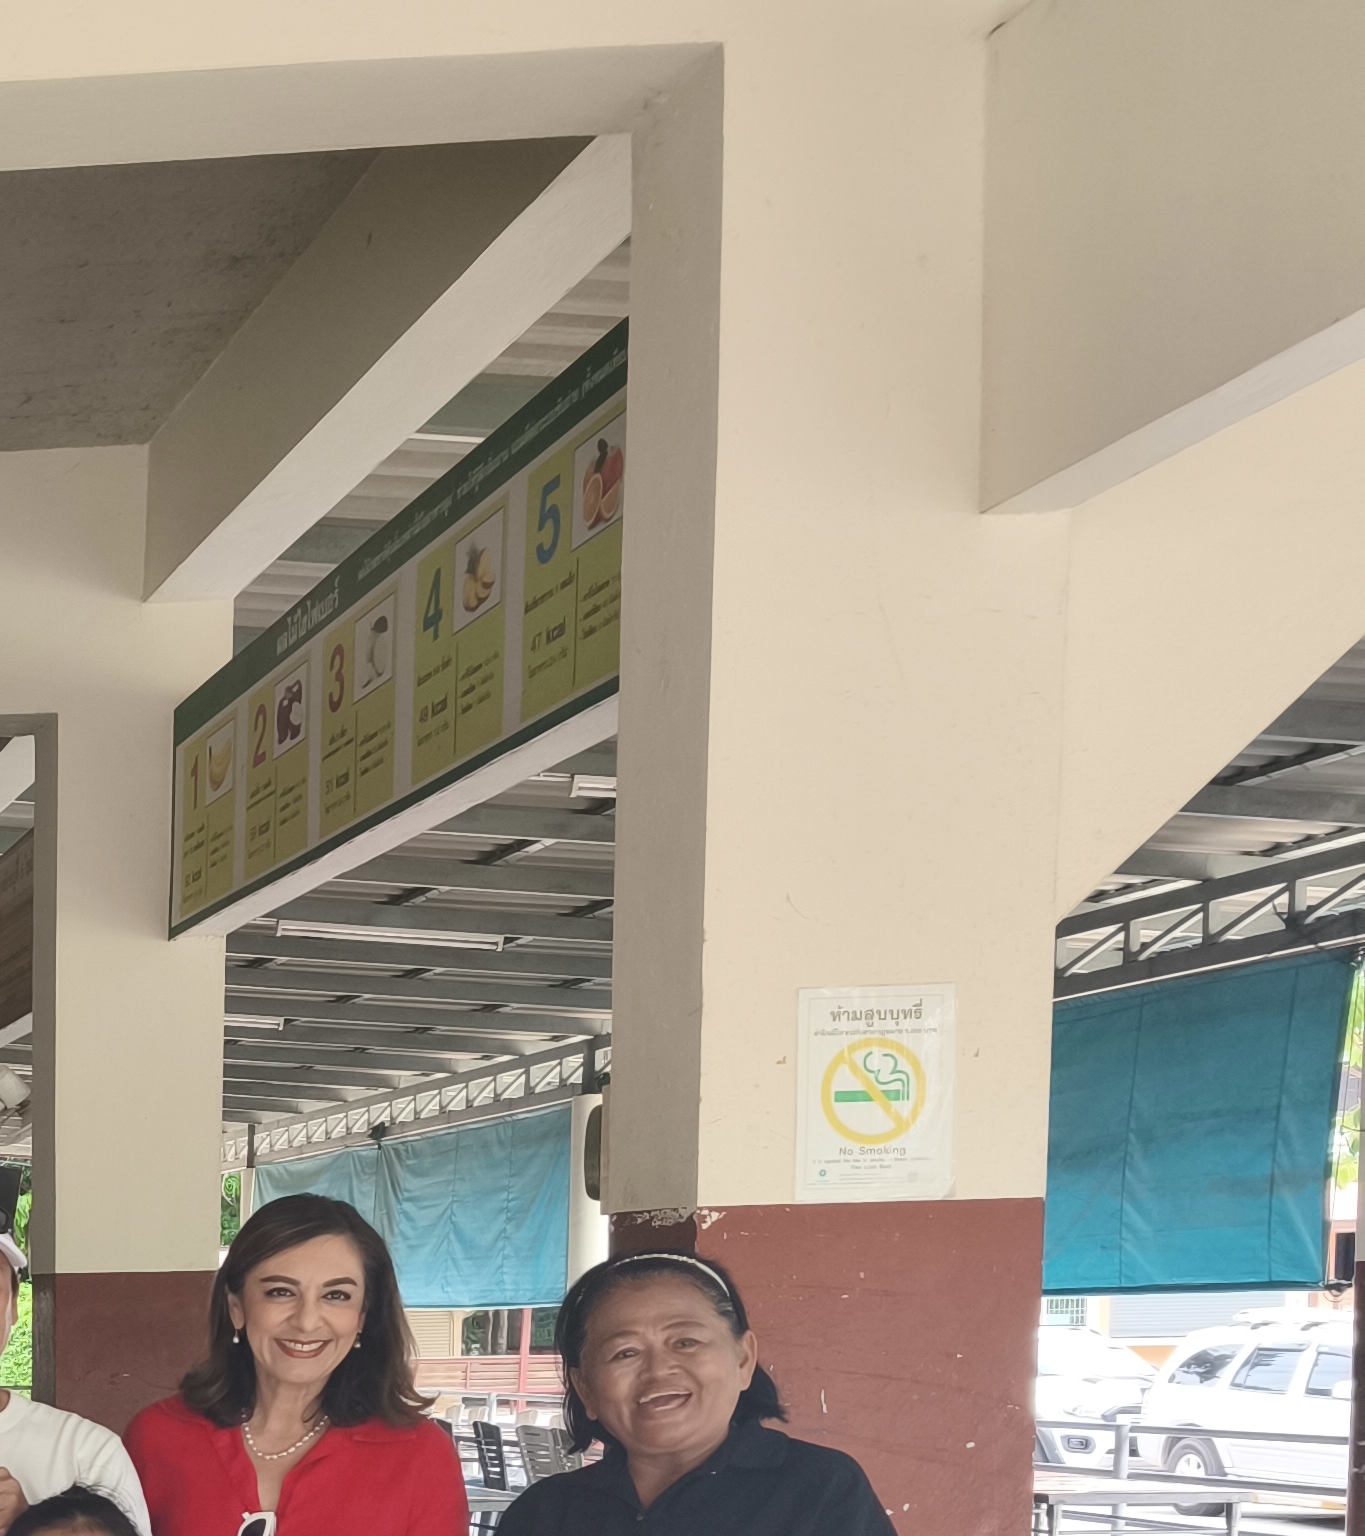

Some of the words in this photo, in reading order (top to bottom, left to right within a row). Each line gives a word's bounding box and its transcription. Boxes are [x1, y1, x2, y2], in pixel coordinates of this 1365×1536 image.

[536, 473, 561, 565] 5
[423, 567, 443, 642] 4
[329, 644, 345, 713] 3
[252, 704, 267, 769] 2
[191, 754, 199, 810] 1
[830, 998, 923, 1027] ห้ามสูบบุหรี่
[839, 1147, 854, 1156] No
[859, 1146, 906, 1156] Smoking
